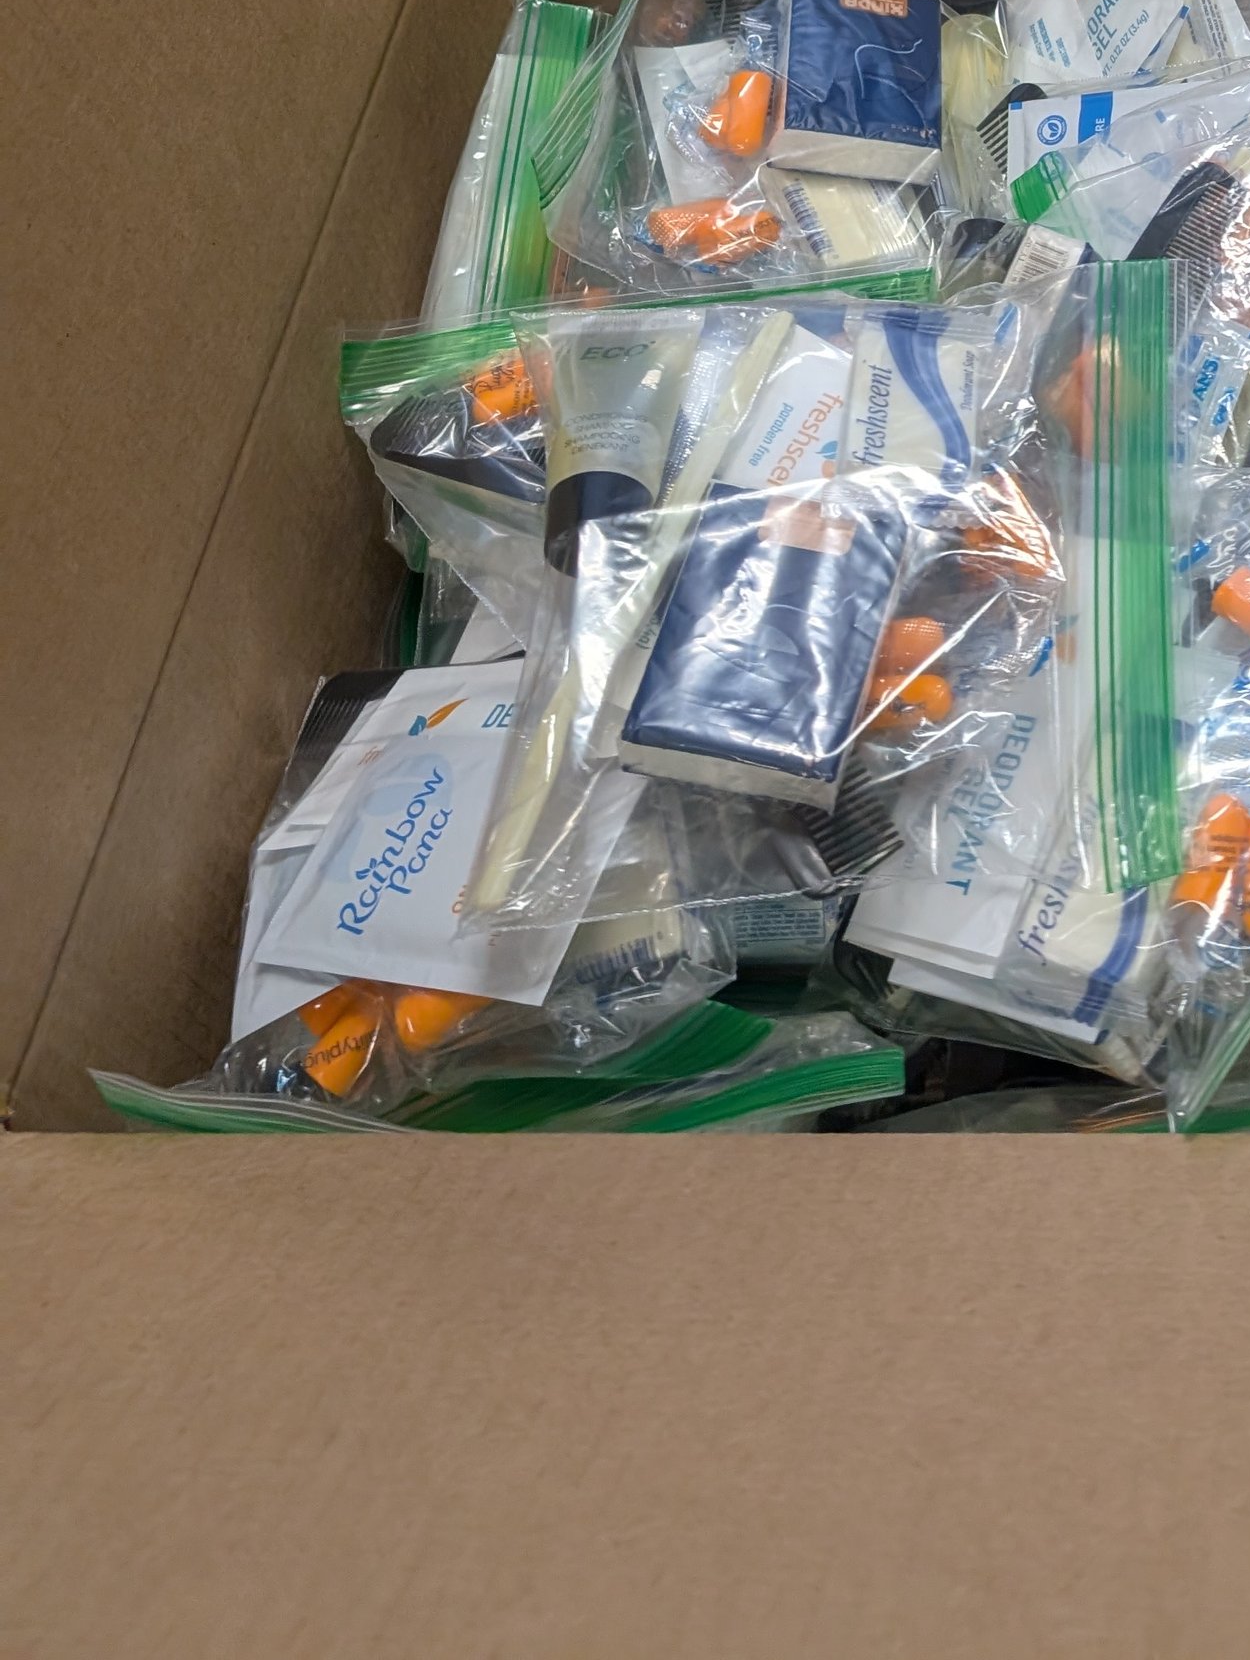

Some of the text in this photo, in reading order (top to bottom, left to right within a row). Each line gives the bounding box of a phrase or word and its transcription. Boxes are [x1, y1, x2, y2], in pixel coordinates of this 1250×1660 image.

[1128, 9, 1150, 37] (3.4g)
[747, 402, 795, 467] paraben free
[853, 364, 893, 468] freshscent
[944, 767, 986, 822] GEL
[944, 713, 1038, 897] DEODORANT
[336, 764, 445, 936] Rainbow
[385, 808, 453, 895] Pana
